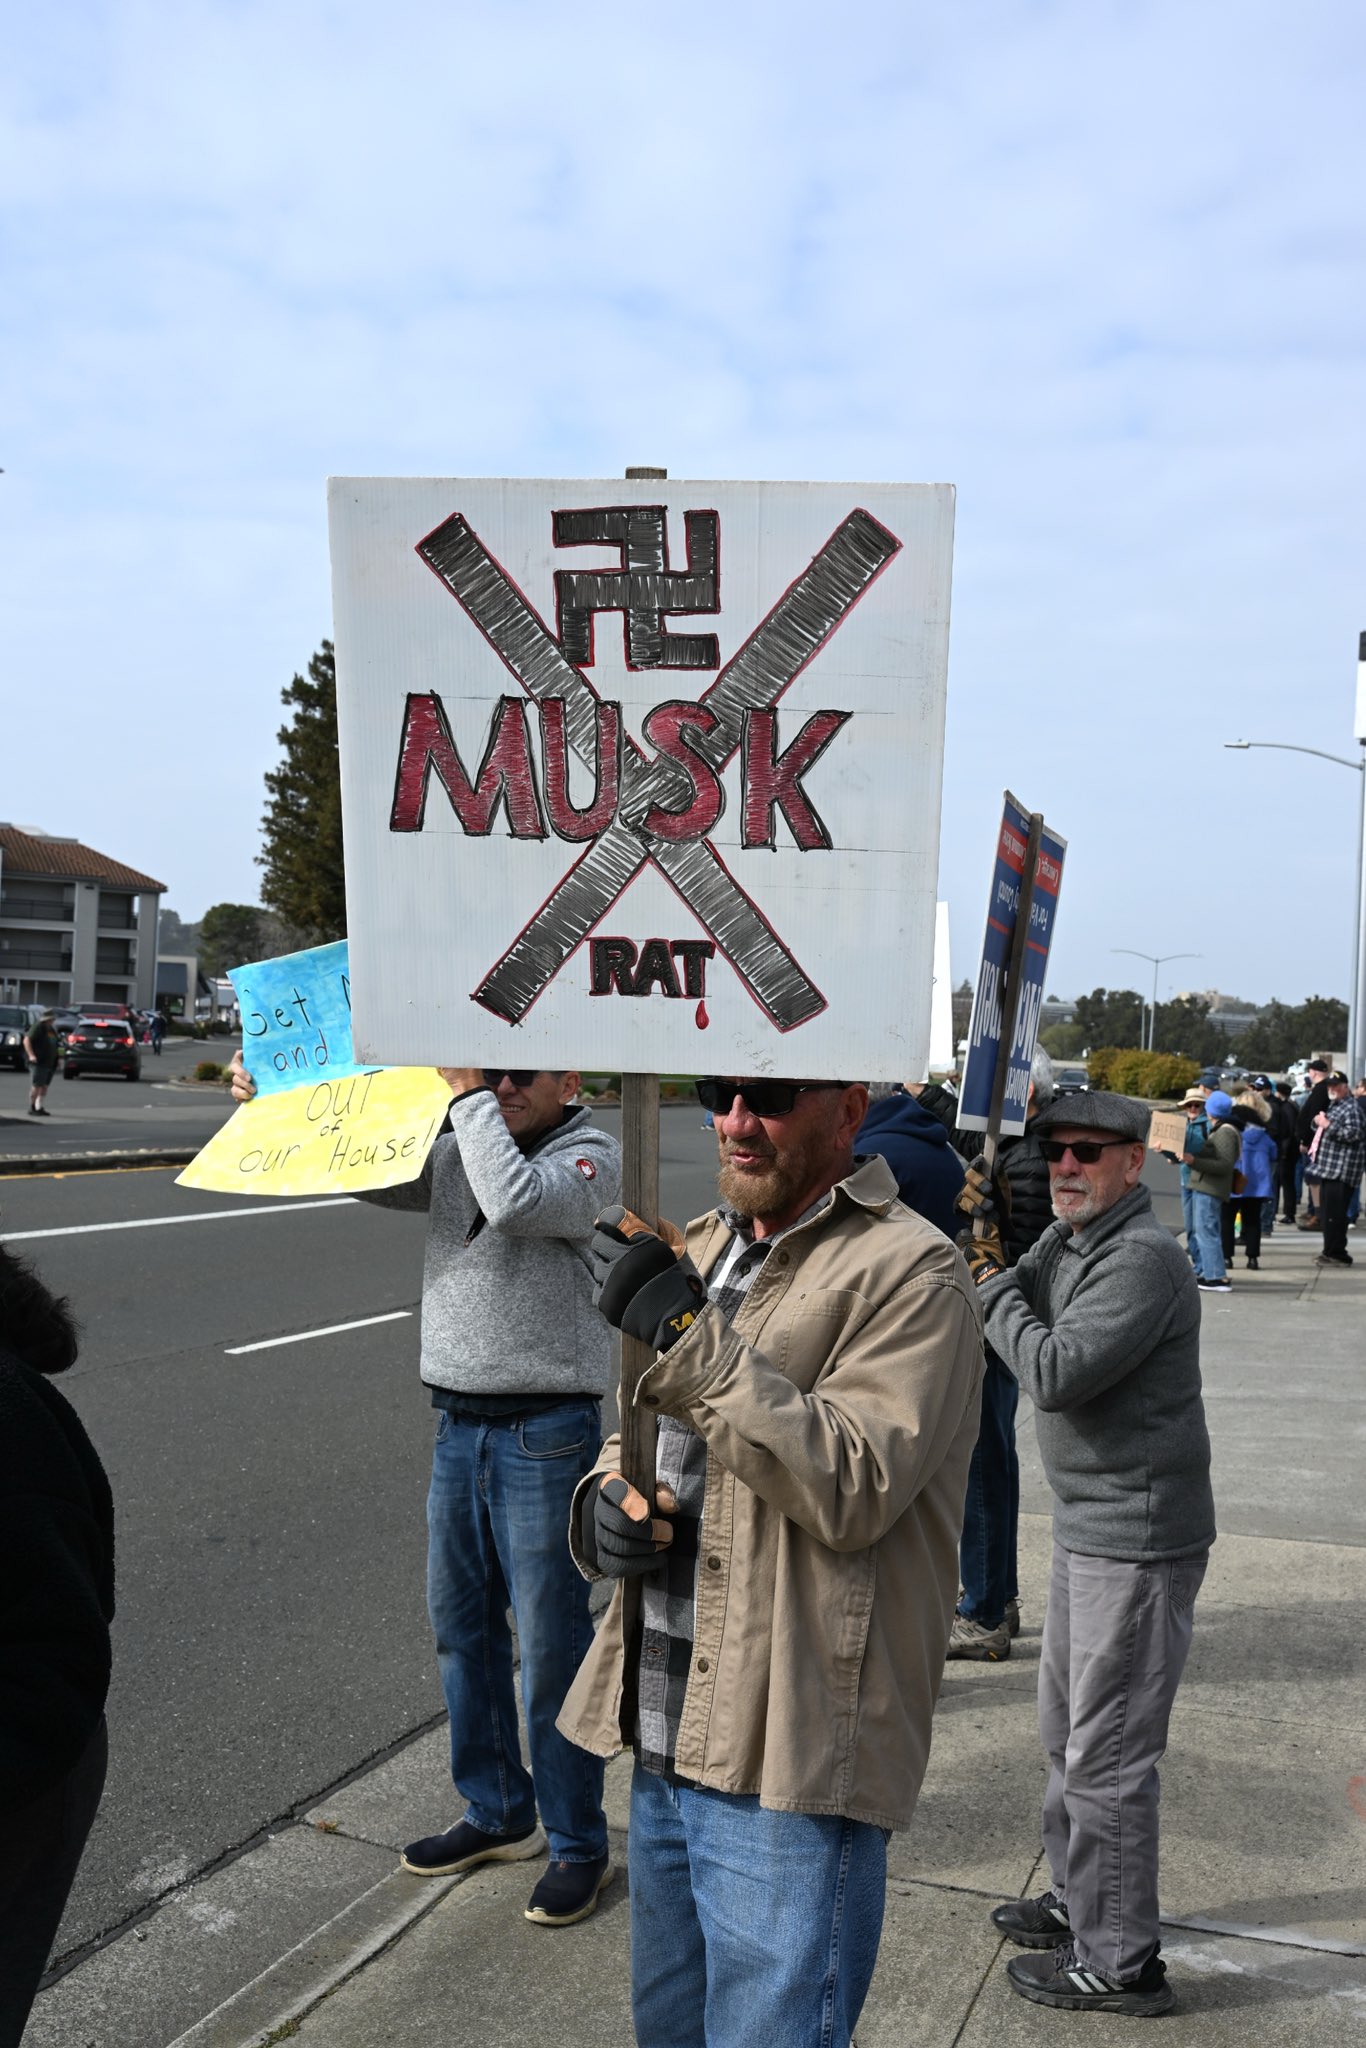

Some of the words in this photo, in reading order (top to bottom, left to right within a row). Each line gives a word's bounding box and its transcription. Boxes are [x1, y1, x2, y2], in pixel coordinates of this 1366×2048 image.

[389, 691, 854, 852] MUSK
[586, 936, 715, 998] RAT
[273, 1028, 329, 1071] and
[306, 1069, 383, 1121] OUT
[319, 1119, 343, 1136] of
[329, 1119, 435, 1173] House!
